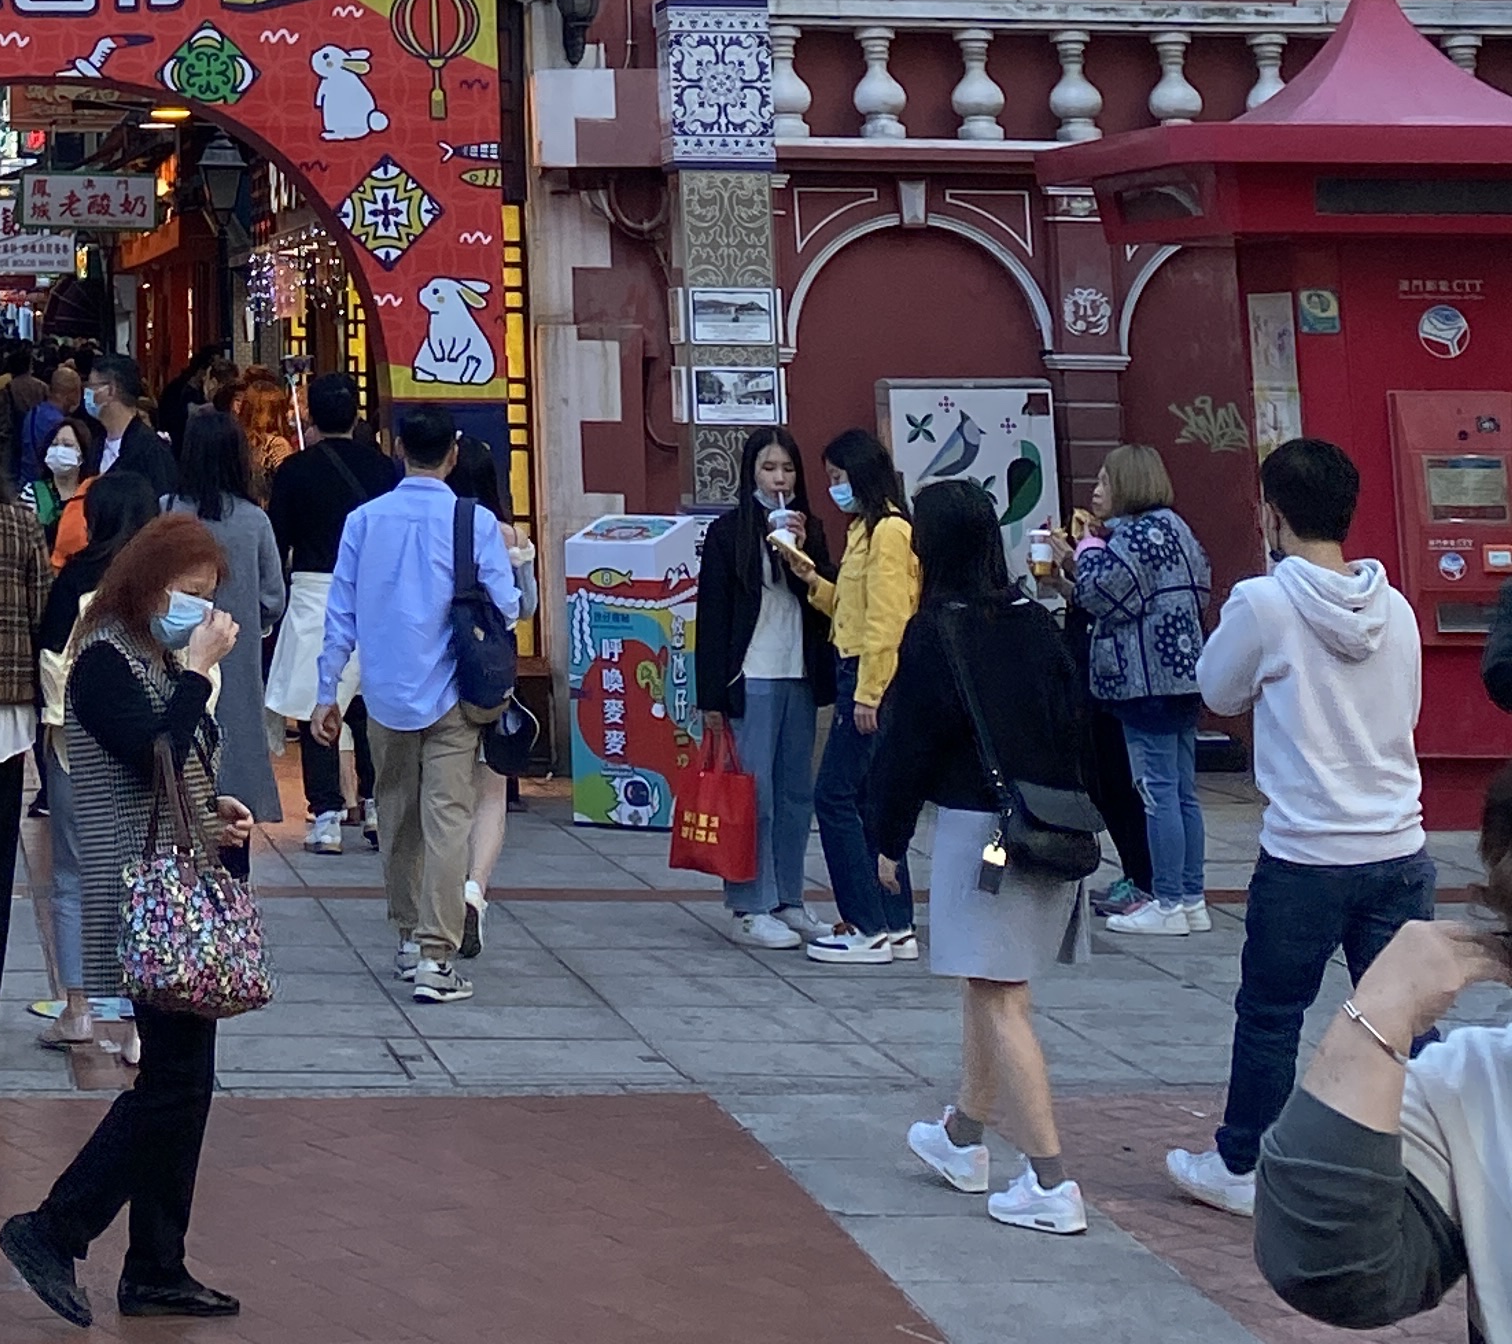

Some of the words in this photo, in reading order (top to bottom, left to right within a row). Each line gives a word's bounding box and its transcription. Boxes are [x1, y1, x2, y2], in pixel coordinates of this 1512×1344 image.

[59, 189, 148, 218] 老酸奶
[1453, 279, 1484, 293] CTT
